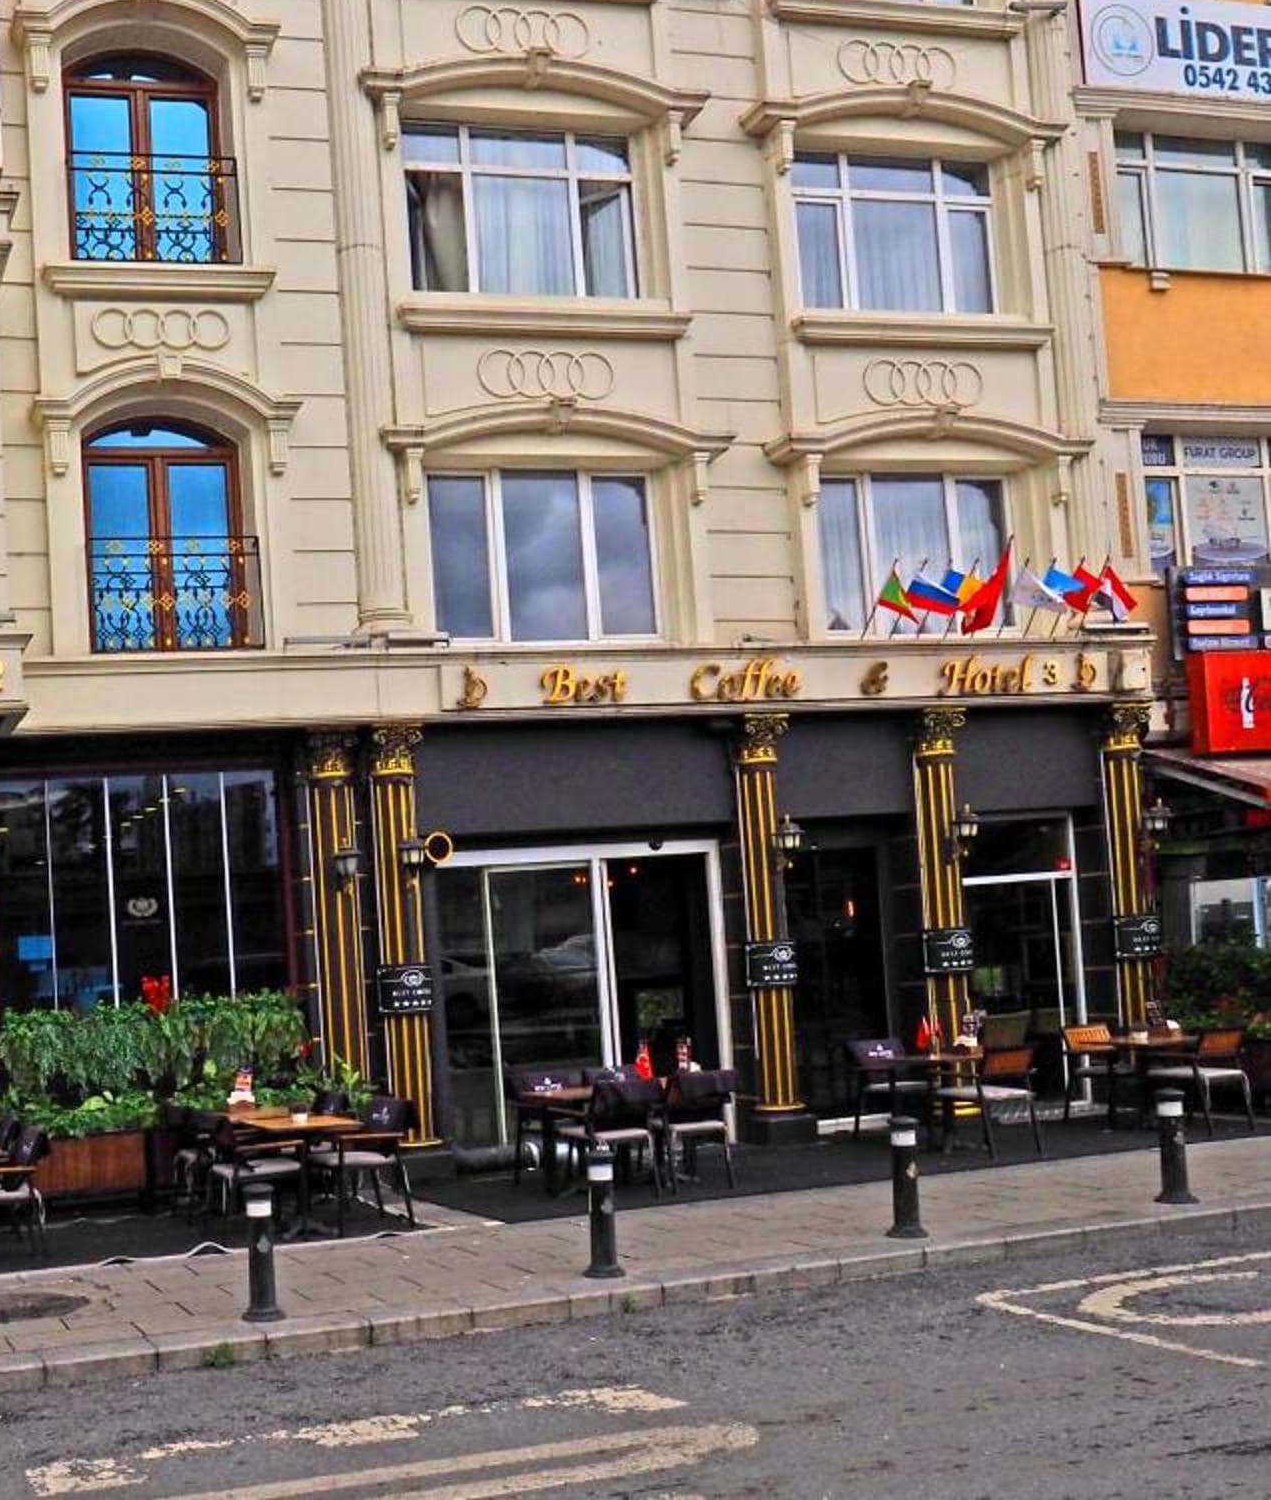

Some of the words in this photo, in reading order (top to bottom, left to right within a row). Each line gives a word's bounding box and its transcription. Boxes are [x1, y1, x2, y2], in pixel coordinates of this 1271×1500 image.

[1184, 64, 1239, 91] 0542
[540, 661, 627, 702] Best
[689, 658, 801, 701] Coffee
[939, 653, 1033, 696] Hotel
